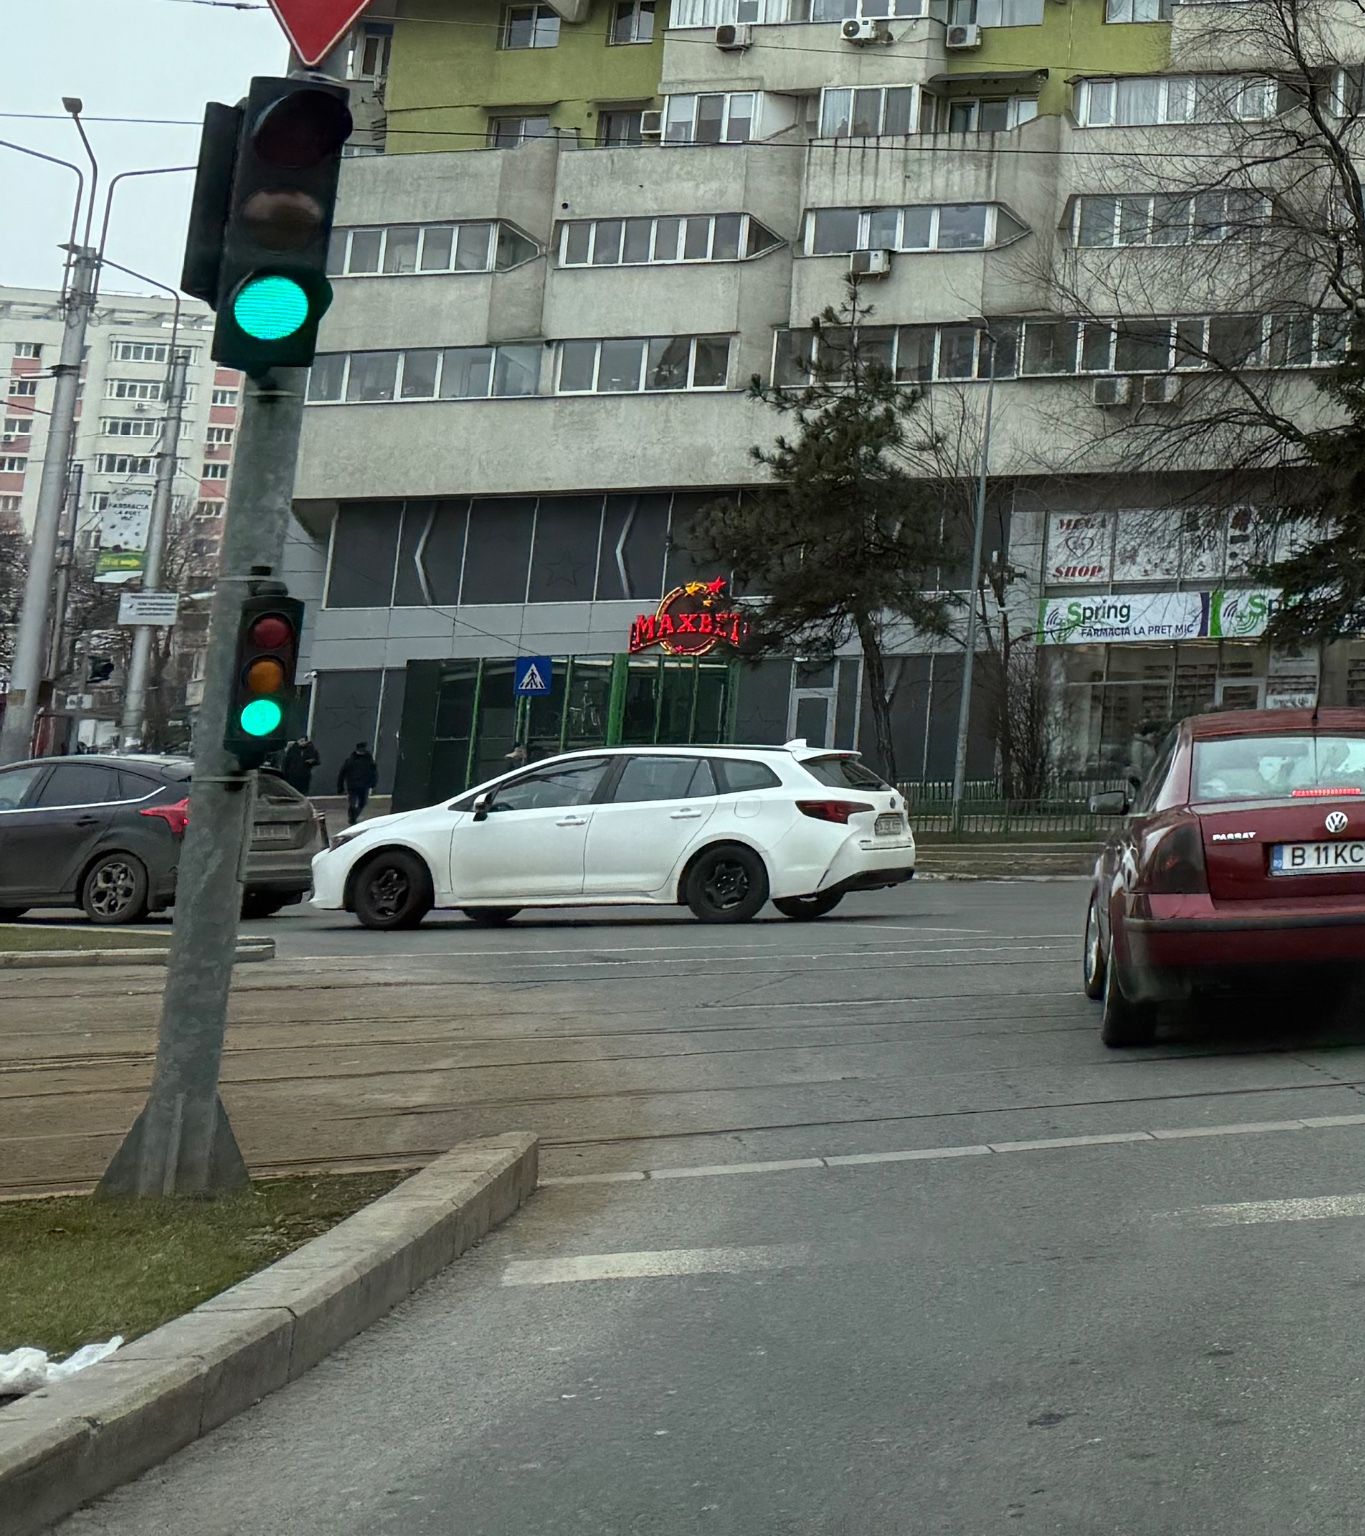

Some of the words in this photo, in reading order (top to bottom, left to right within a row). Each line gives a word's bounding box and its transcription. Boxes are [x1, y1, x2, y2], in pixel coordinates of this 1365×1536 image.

[1052, 565, 1105, 578] SHOP
[1067, 599, 1131, 624] Spring
[635, 612, 742, 644] MAXBET
[1081, 626, 1131, 638] FARMACIA
[1133, 626, 1147, 636] LA
[1175, 623, 1195, 634] MIC
[1291, 846, 1306, 867] B
[1314, 844, 1330, 865] 11
